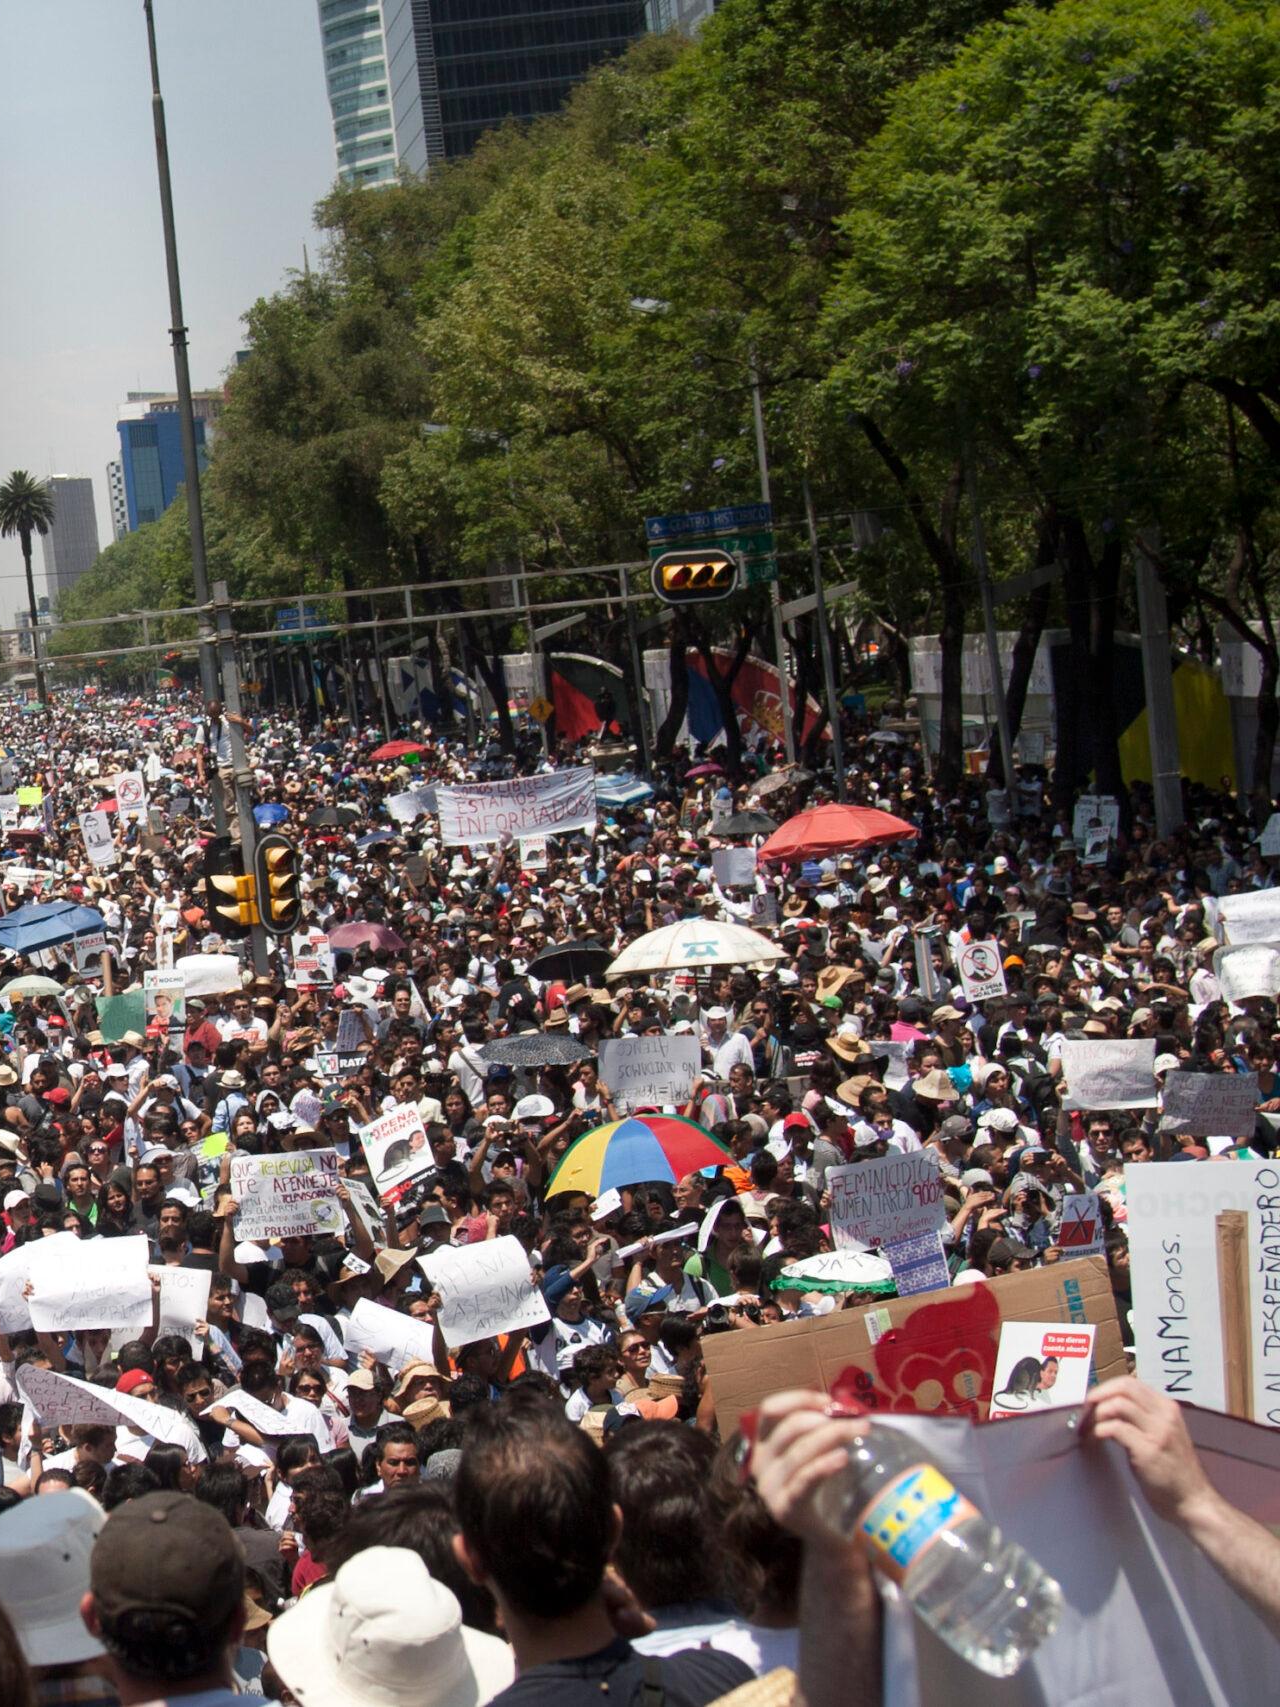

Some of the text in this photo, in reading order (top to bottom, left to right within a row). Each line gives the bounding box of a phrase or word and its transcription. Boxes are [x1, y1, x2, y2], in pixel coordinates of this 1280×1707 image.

[669, 515, 710, 531] CENTRO
[452, 784, 493, 800] SOMOS
[497, 776, 551, 796] LIBRES
[457, 791, 538, 816] ESTAMOS
[454, 794, 591, 838] INFORMADOS
[382, 1117, 419, 1140] MIENTO
[320, 1155, 337, 1172] NO
[264, 1223, 319, 1237] PRESIDENTE
